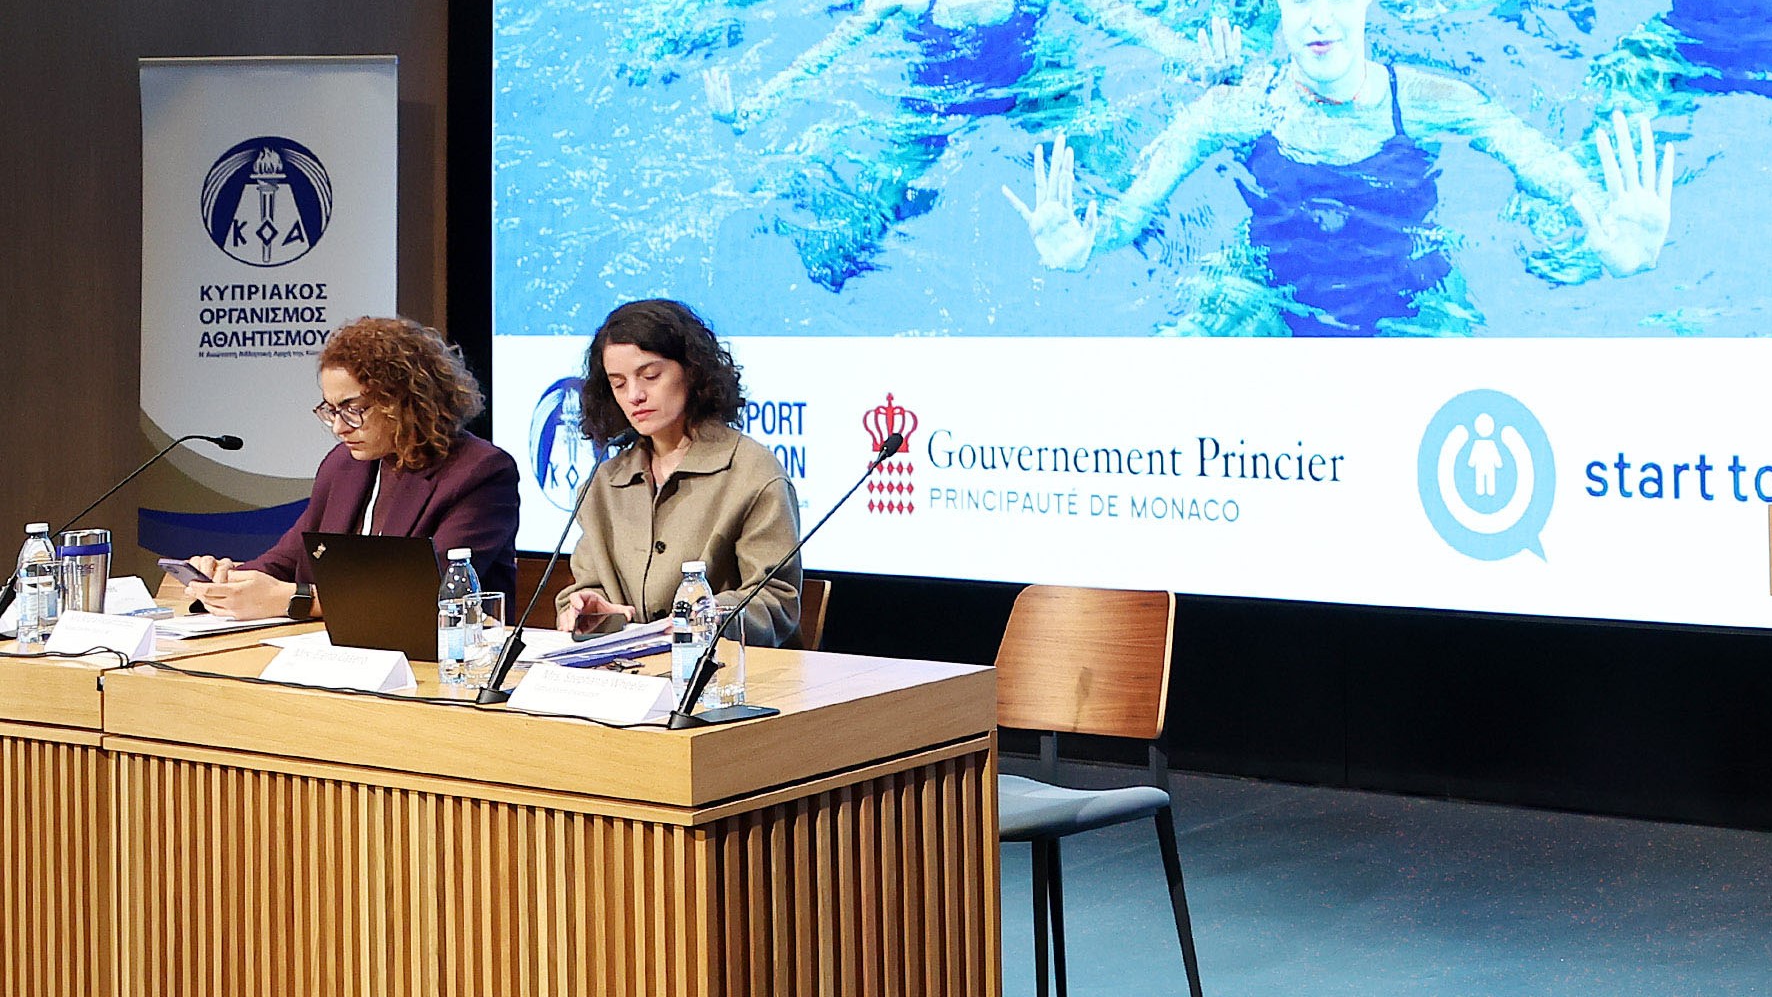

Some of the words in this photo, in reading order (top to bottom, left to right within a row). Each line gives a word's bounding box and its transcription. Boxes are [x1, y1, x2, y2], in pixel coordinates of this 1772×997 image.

[200, 283, 328, 302] ΚΥΠΡΙΑΚΟΣ
[199, 306, 327, 325] ΟΡΓΑΝΙΣΜΟΣ
[199, 329, 331, 348] ΑΘΛΗΤΙΣΜΟΥ
[927, 429, 1183, 477] Gouvernement
[1195, 435, 1345, 483] Princier
[1585, 452, 1715, 502] start
[929, 487, 1079, 516] PRINCIPAUTÉ
[1090, 494, 1120, 518] DE
[1130, 496, 1240, 523] MONACO
